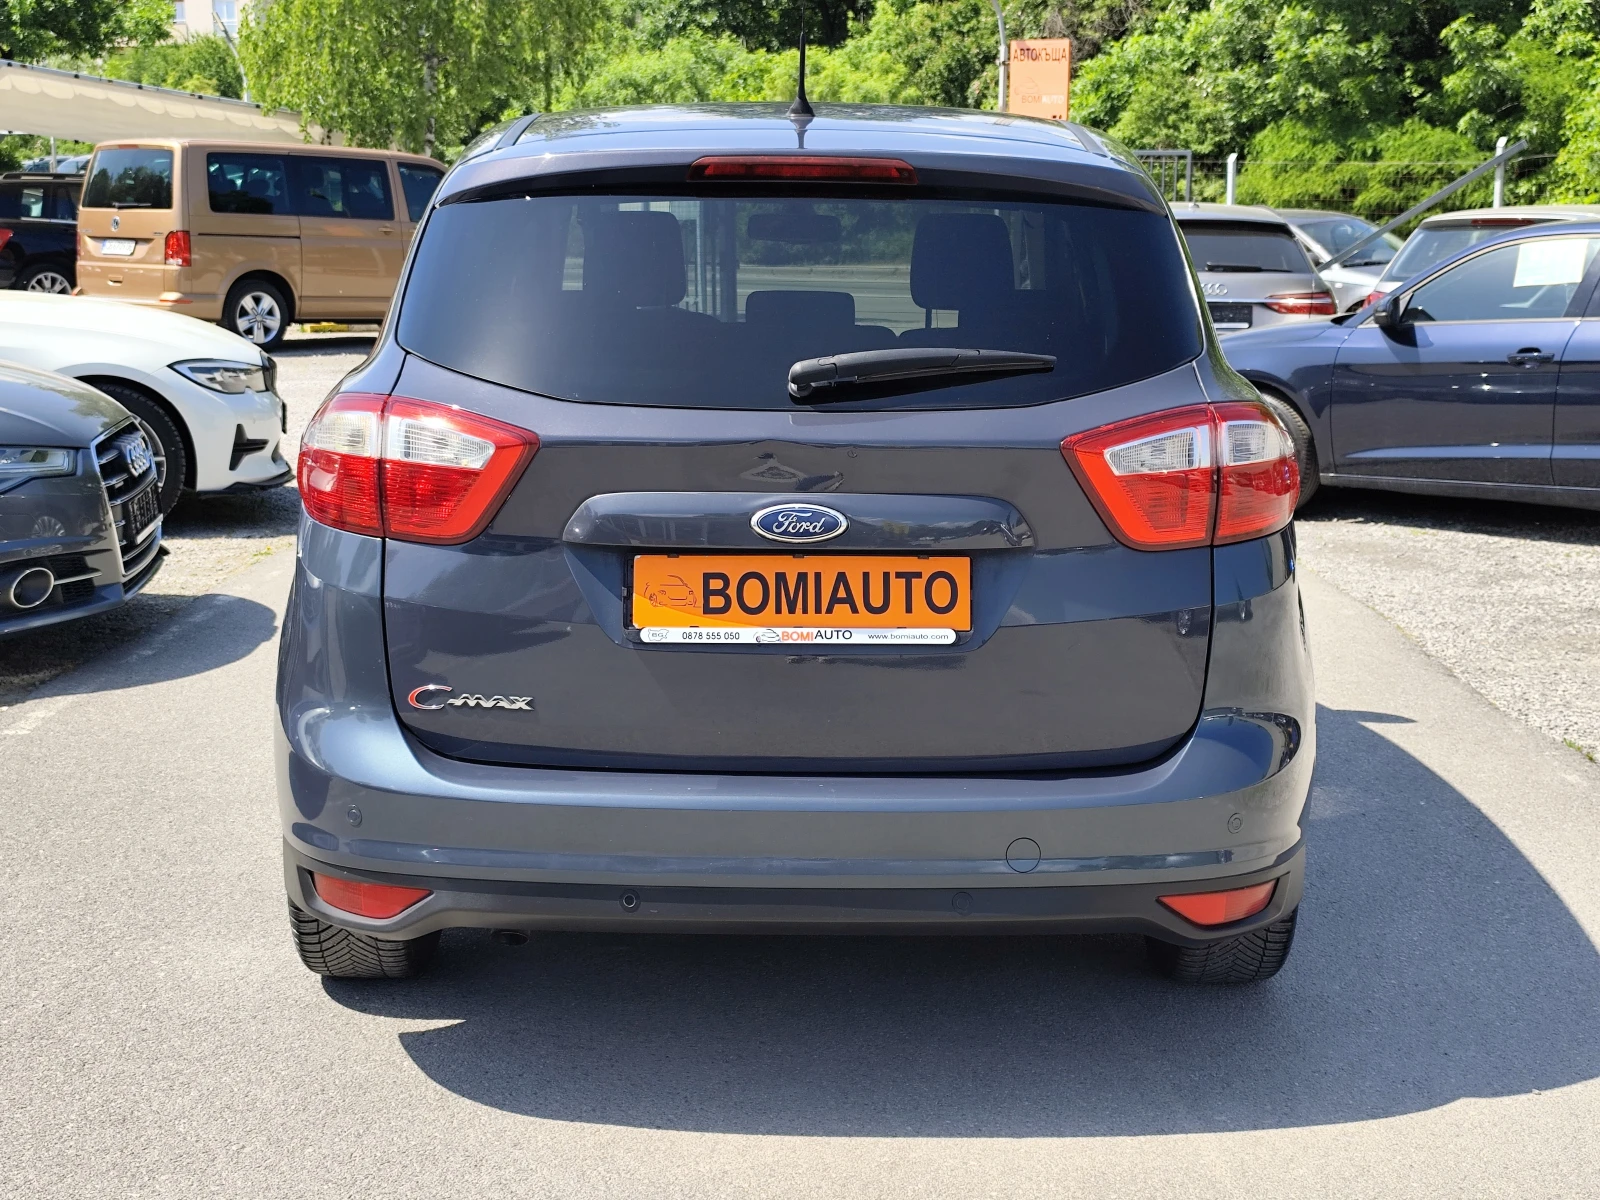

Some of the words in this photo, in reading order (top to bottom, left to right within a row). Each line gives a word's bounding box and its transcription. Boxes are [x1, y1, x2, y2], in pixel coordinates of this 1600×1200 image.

[772, 511, 826, 533] Ford
[702, 570, 959, 616] BOMIAUTO
[682, 631, 703, 640] 0878
[706, 631, 721, 640] 555
[724, 631, 740, 640] 050
[782, 629, 853, 642] BOMIAUTO
[867, 632, 949, 640] www.bomiauto.com
